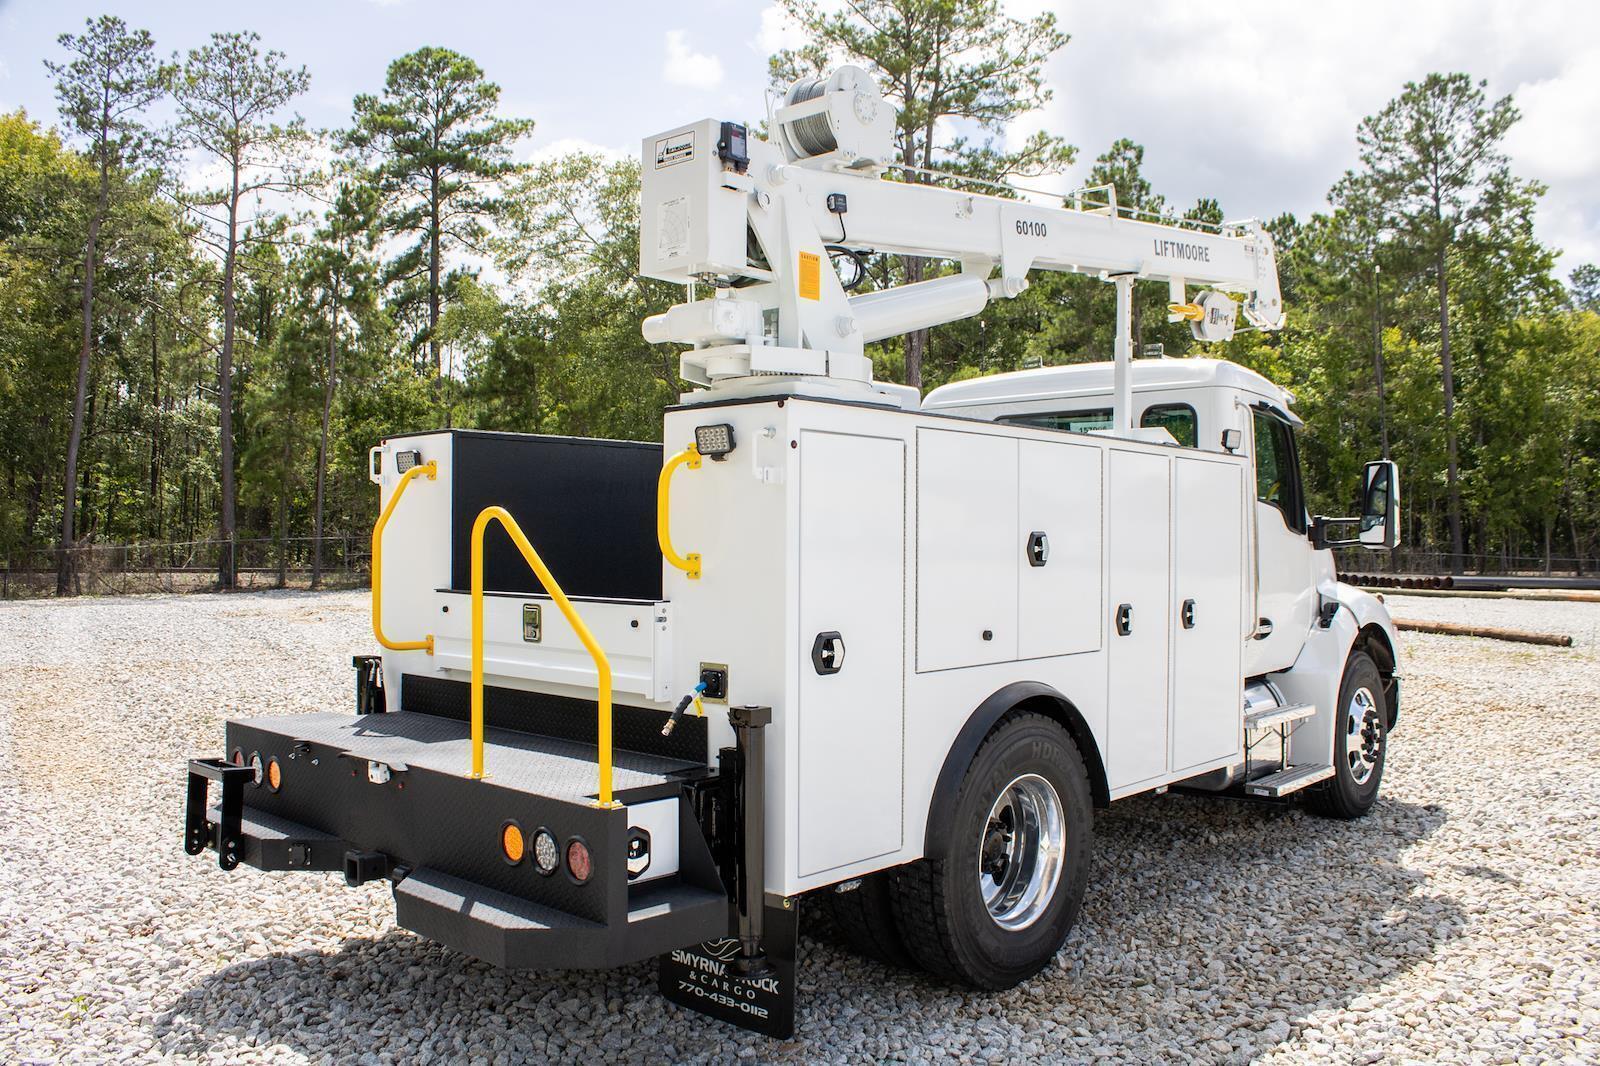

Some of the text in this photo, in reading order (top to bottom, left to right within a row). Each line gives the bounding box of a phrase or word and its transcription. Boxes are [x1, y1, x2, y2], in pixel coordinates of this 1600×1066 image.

[1016, 220, 1047, 237] 60100
[1154, 239, 1210, 262] LIFTMOORE
[689, 970, 756, 1000] & CARGO
[736, 977, 779, 995] UCK
[678, 980, 769, 1019] 770-433-0112
